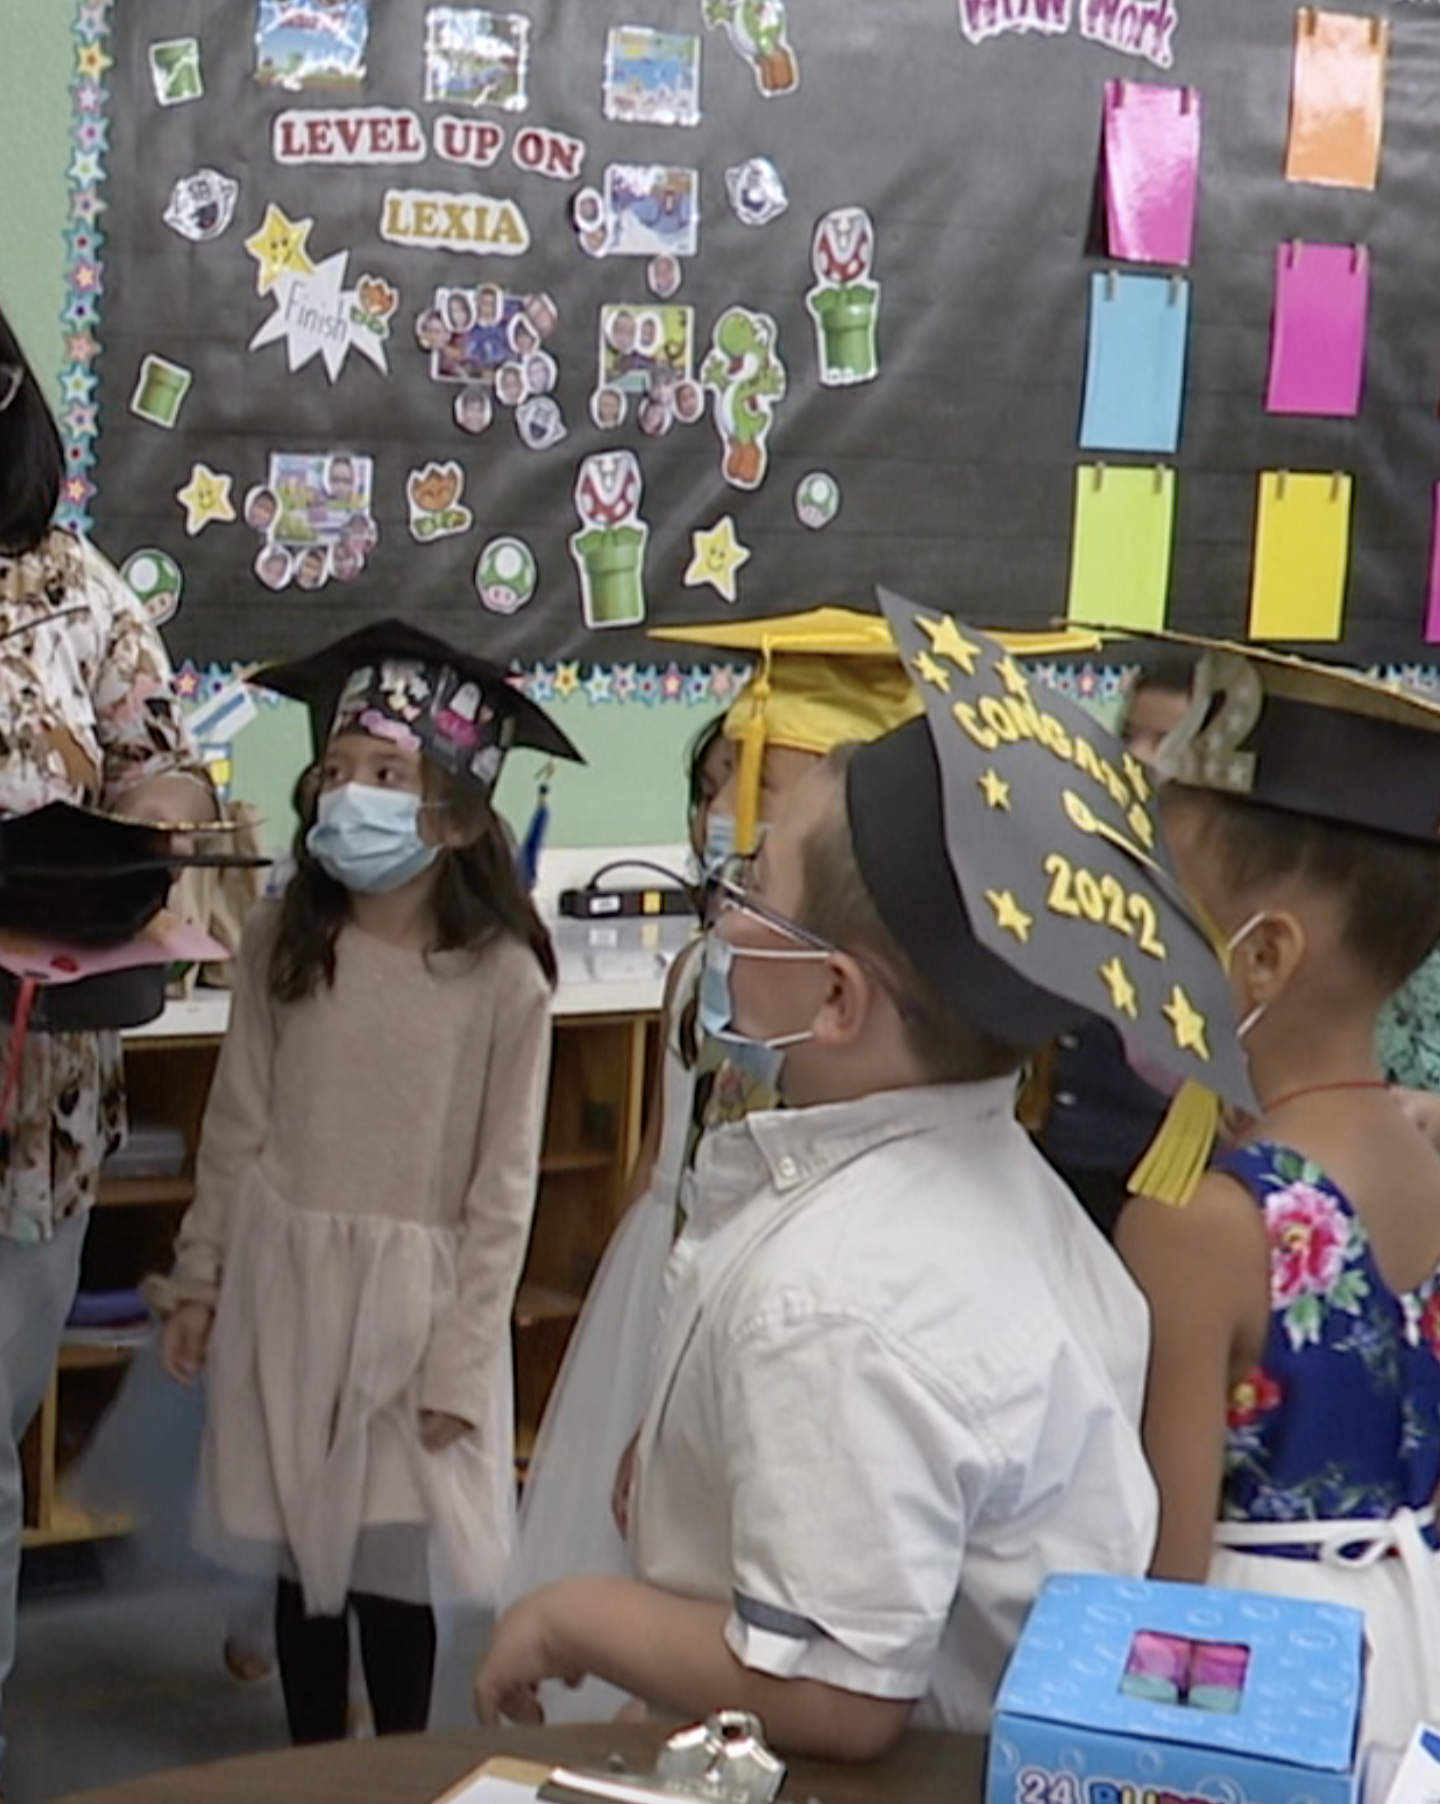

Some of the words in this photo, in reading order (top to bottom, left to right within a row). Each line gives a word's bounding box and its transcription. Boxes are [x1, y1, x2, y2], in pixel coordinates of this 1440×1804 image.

[280, 117, 420, 156] LEVEL
[441, 123, 500, 160] UP
[517, 132, 579, 173] ON
[386, 200, 524, 244] LEXIA
[284, 279, 348, 343] Finish
[1044, 853, 1166, 962] 2022
[1020, 1769, 1076, 1804] 24
